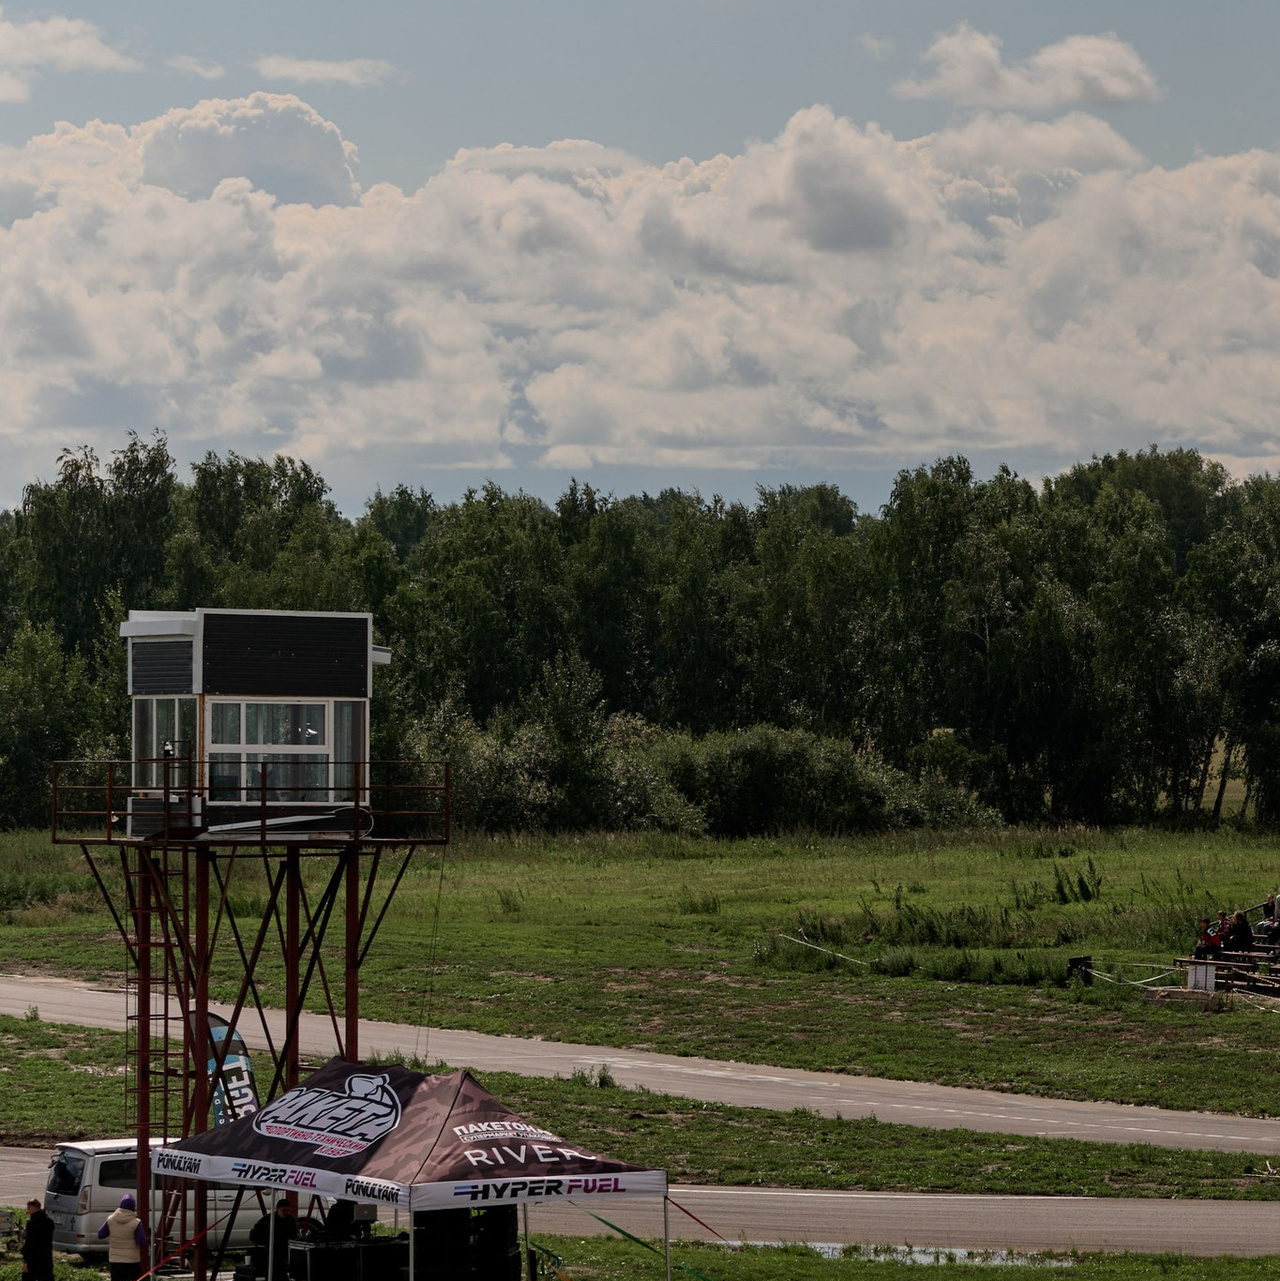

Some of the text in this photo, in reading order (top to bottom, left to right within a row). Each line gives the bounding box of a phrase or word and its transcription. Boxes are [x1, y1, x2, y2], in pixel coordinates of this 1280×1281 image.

[260, 1089, 394, 1142] РАКЕТА
[232, 1162, 317, 1188] HYPER FUEL
[454, 1177, 627, 1201] HYPER FUEL
